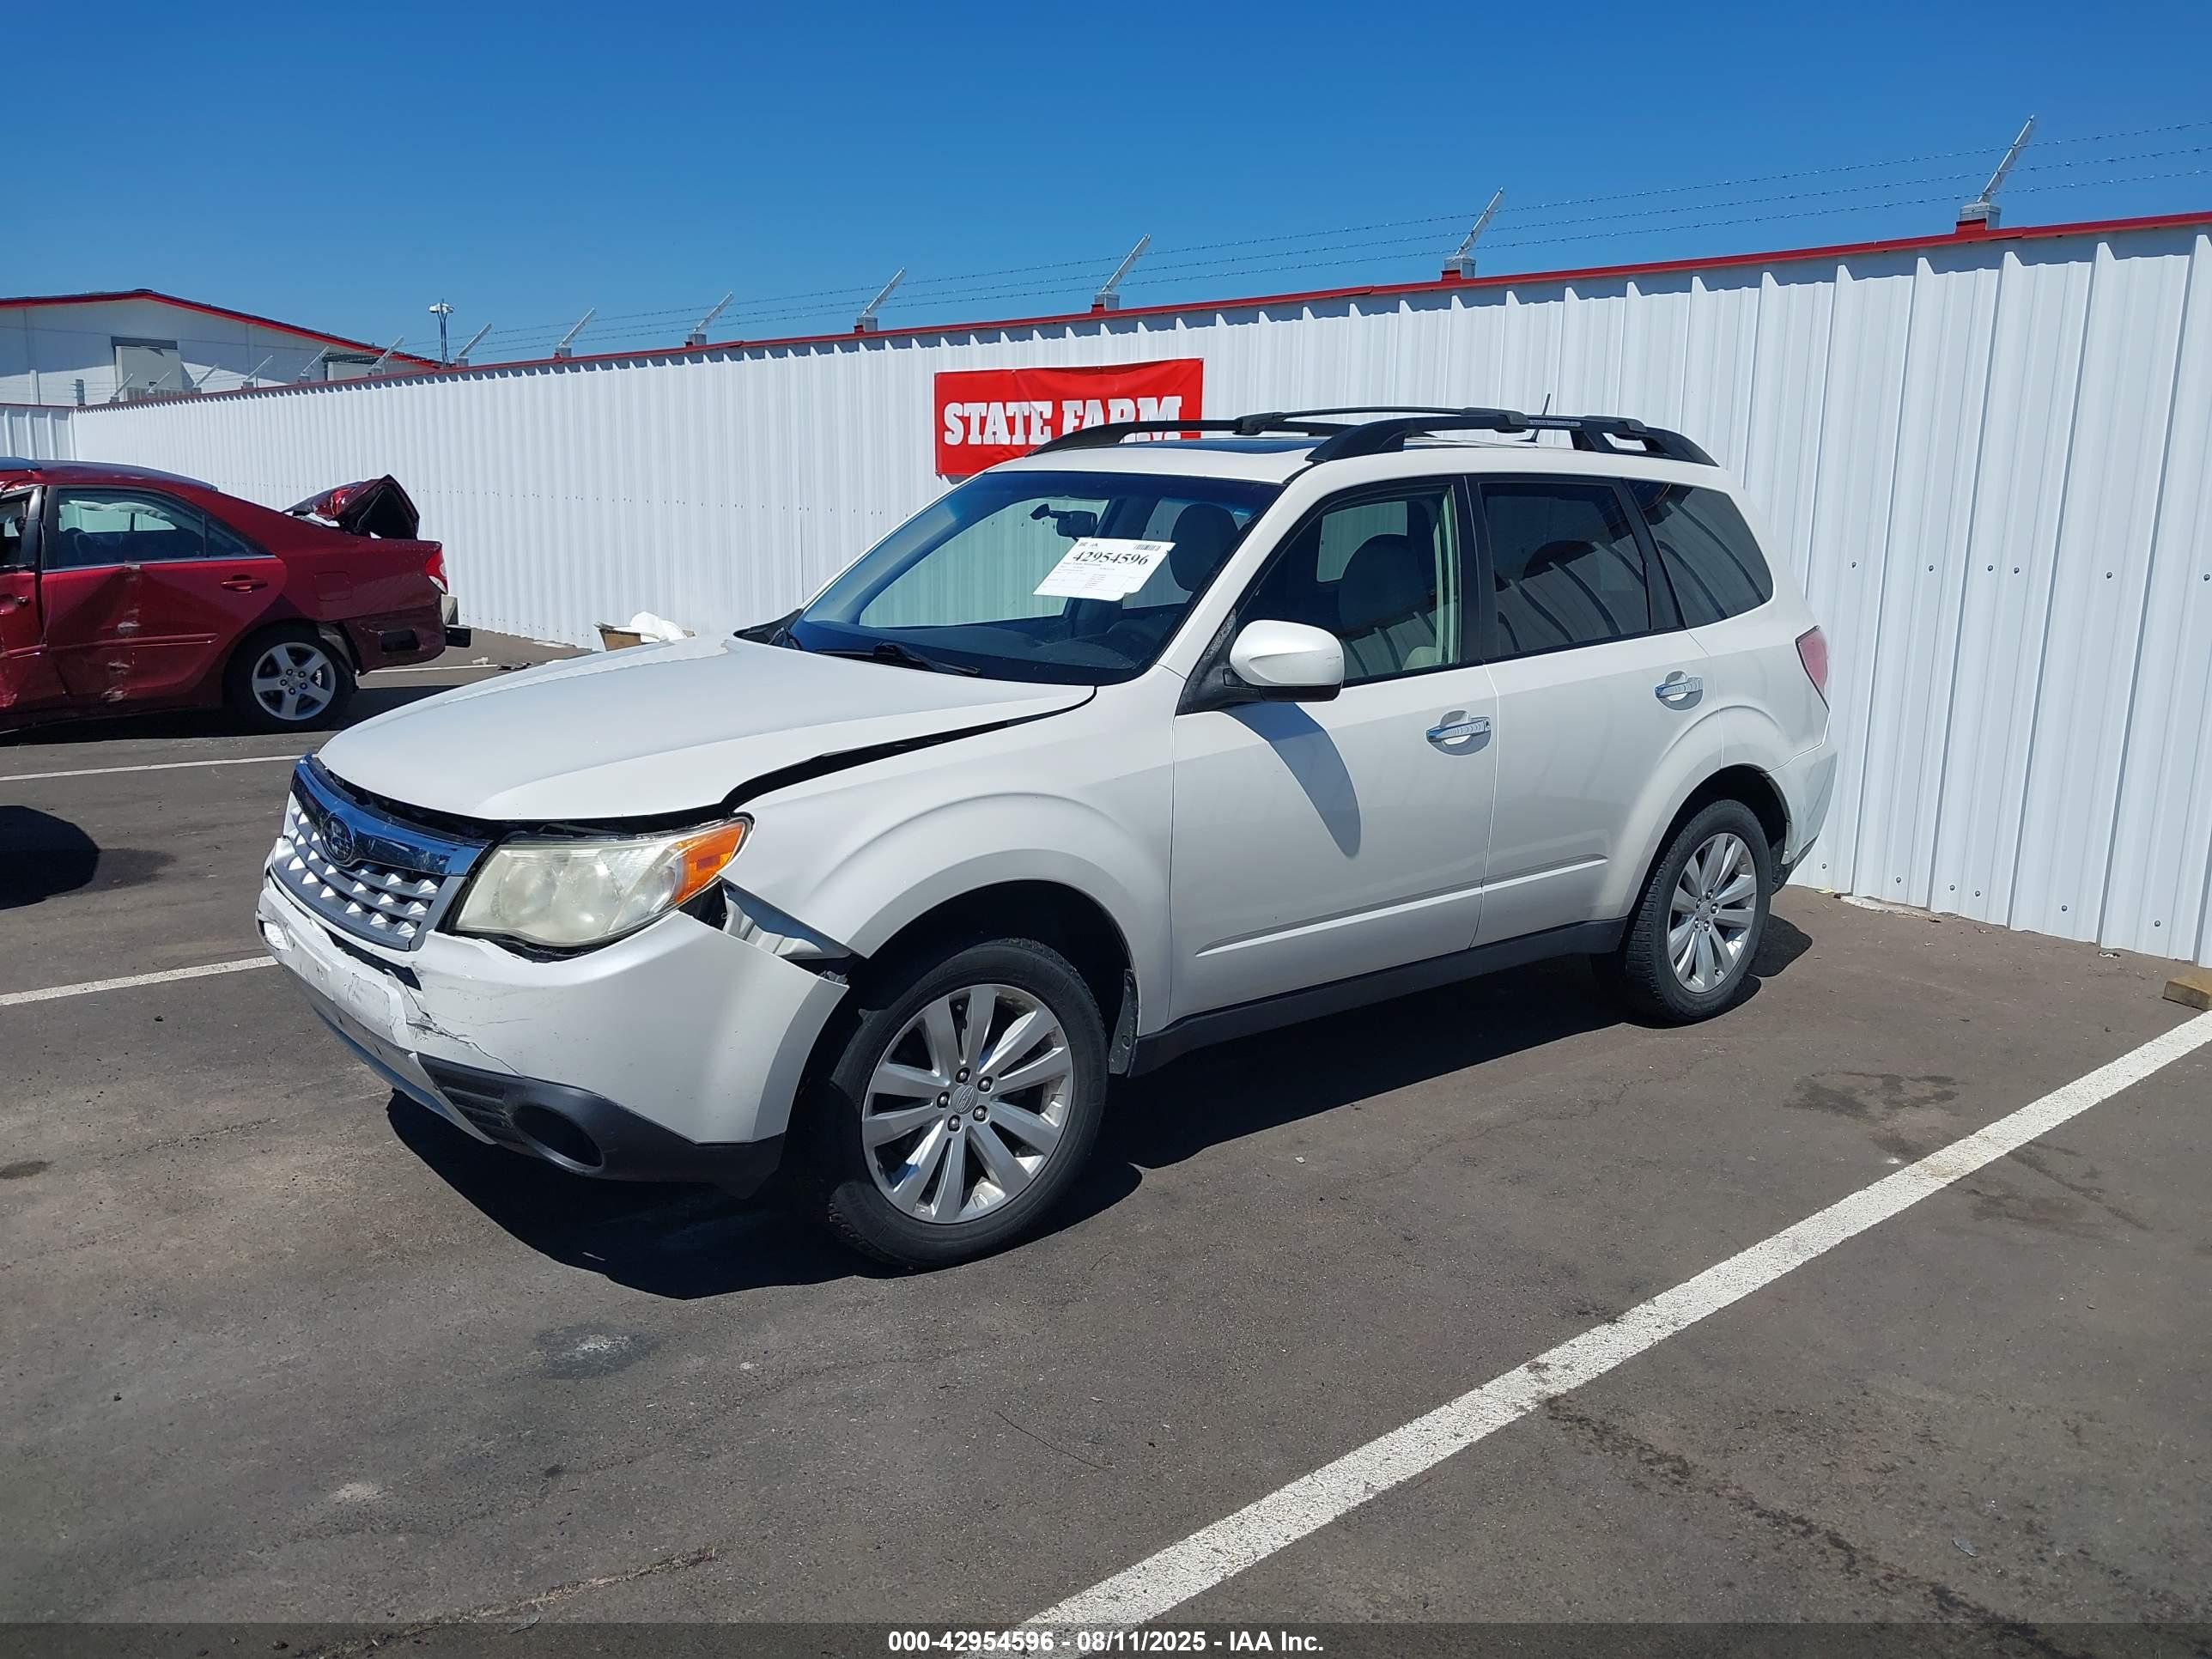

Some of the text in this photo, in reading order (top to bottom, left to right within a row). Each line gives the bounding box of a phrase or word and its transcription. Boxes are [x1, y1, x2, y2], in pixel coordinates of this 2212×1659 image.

[944, 395, 1182, 446] STATE FARM
[1073, 550, 1149, 566] 42954596
